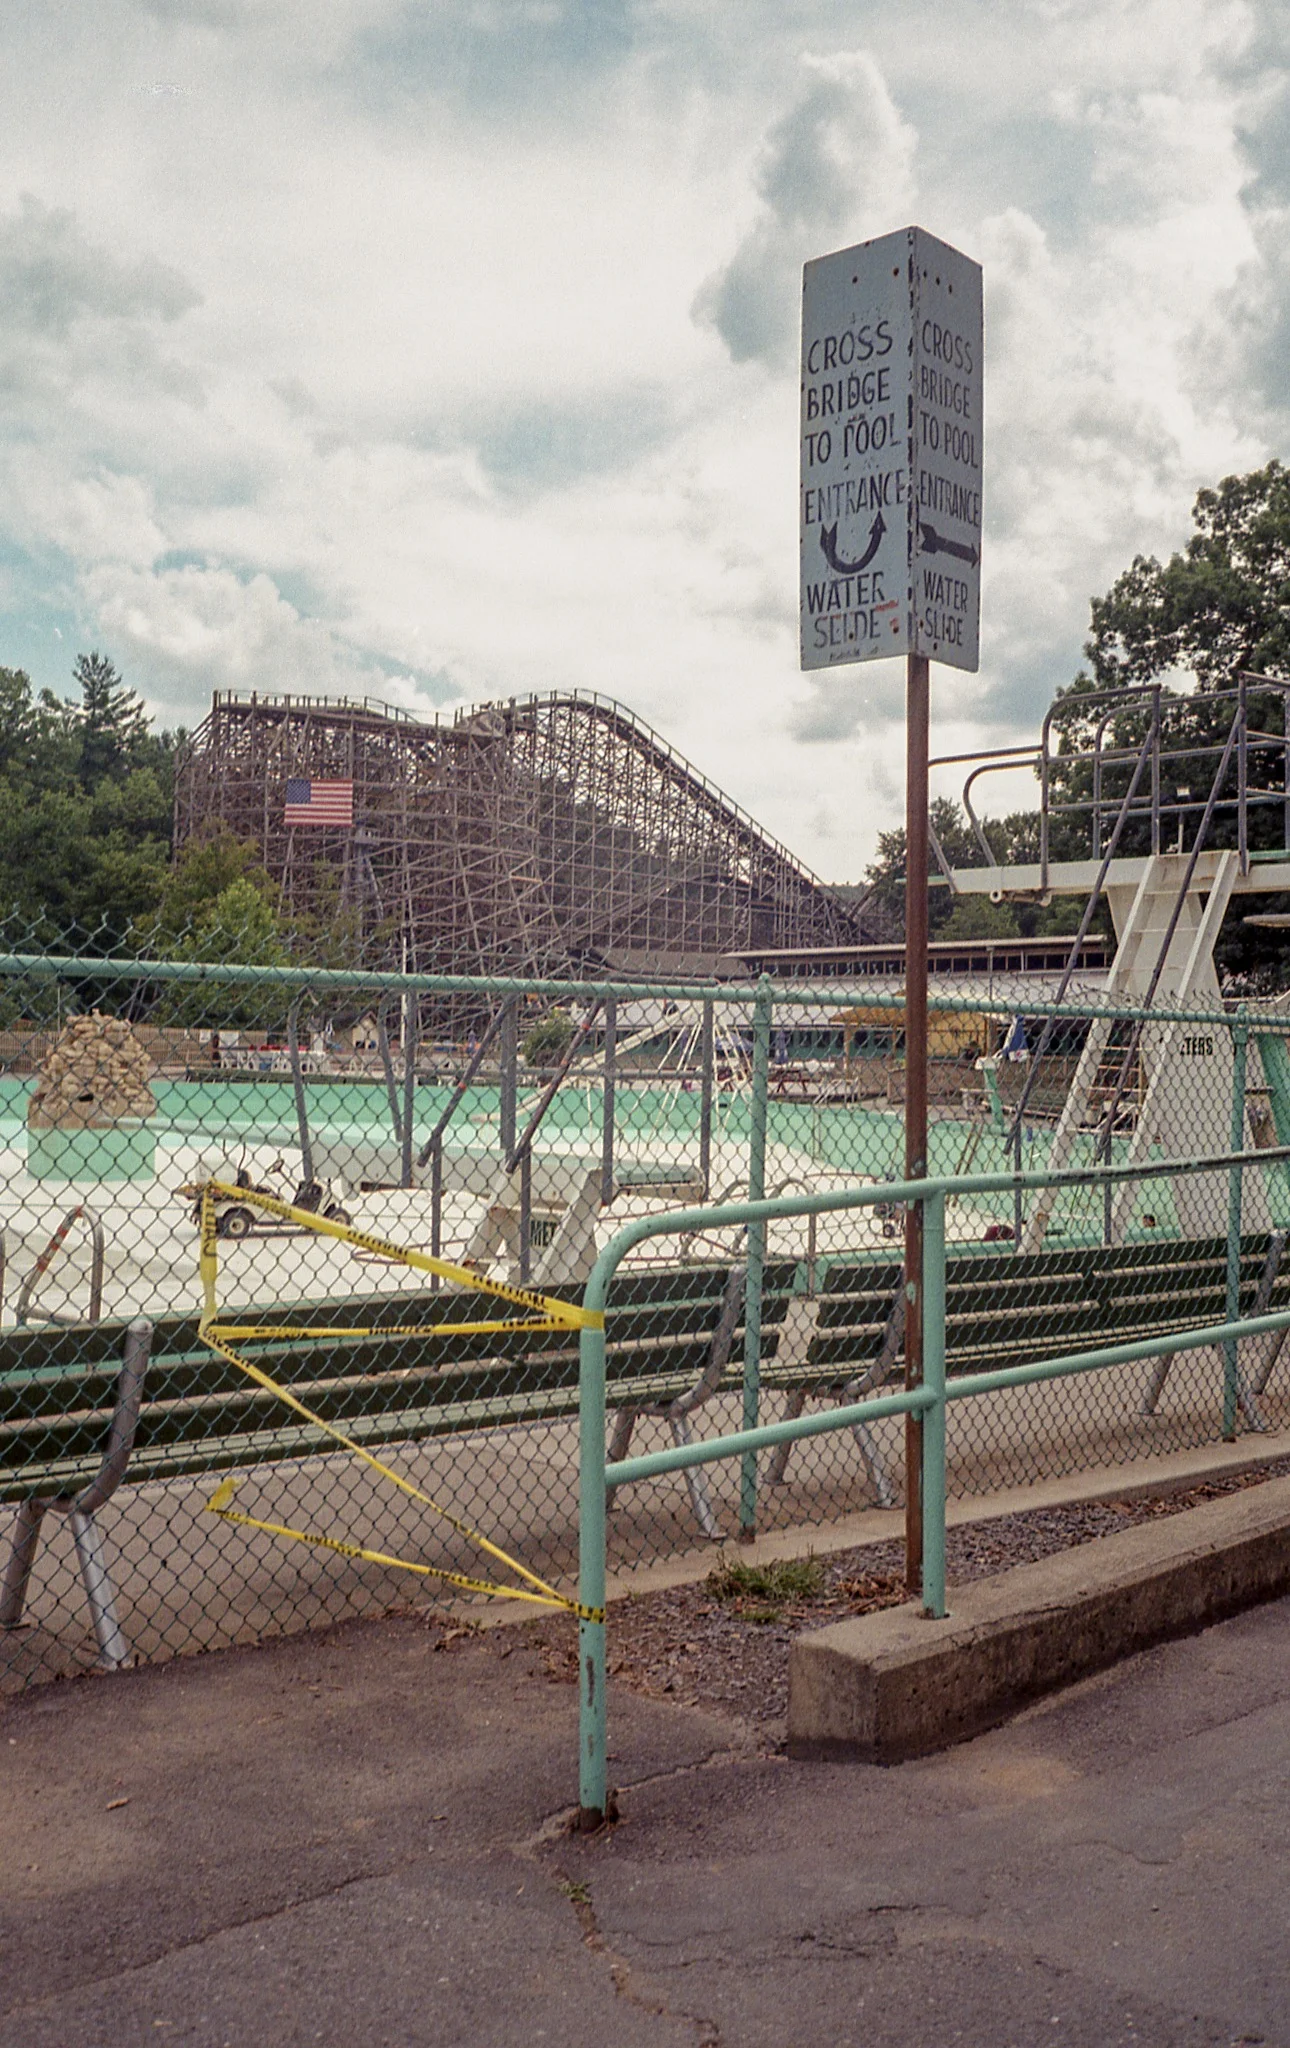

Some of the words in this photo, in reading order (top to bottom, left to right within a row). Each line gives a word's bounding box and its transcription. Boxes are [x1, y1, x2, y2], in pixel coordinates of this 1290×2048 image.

[807, 320, 893, 374] CROSS
[922, 320, 973, 374] CROSS
[806, 367, 891, 420] BRIDGE
[920, 365, 971, 419] BRIDGE
[805, 430, 831, 467] TO
[843, 412, 901, 458] POOL
[920, 410, 939, 450] TO
[944, 423, 978, 469] POOL
[805, 469, 906, 525] ENTRANCE
[920, 469, 980, 527] ENTRANCE
[807, 571, 885, 614] WATER
[923, 569, 968, 613] WATER
[814, 608, 881, 648] SLIDE
[924, 607, 963, 646] SLIDE
